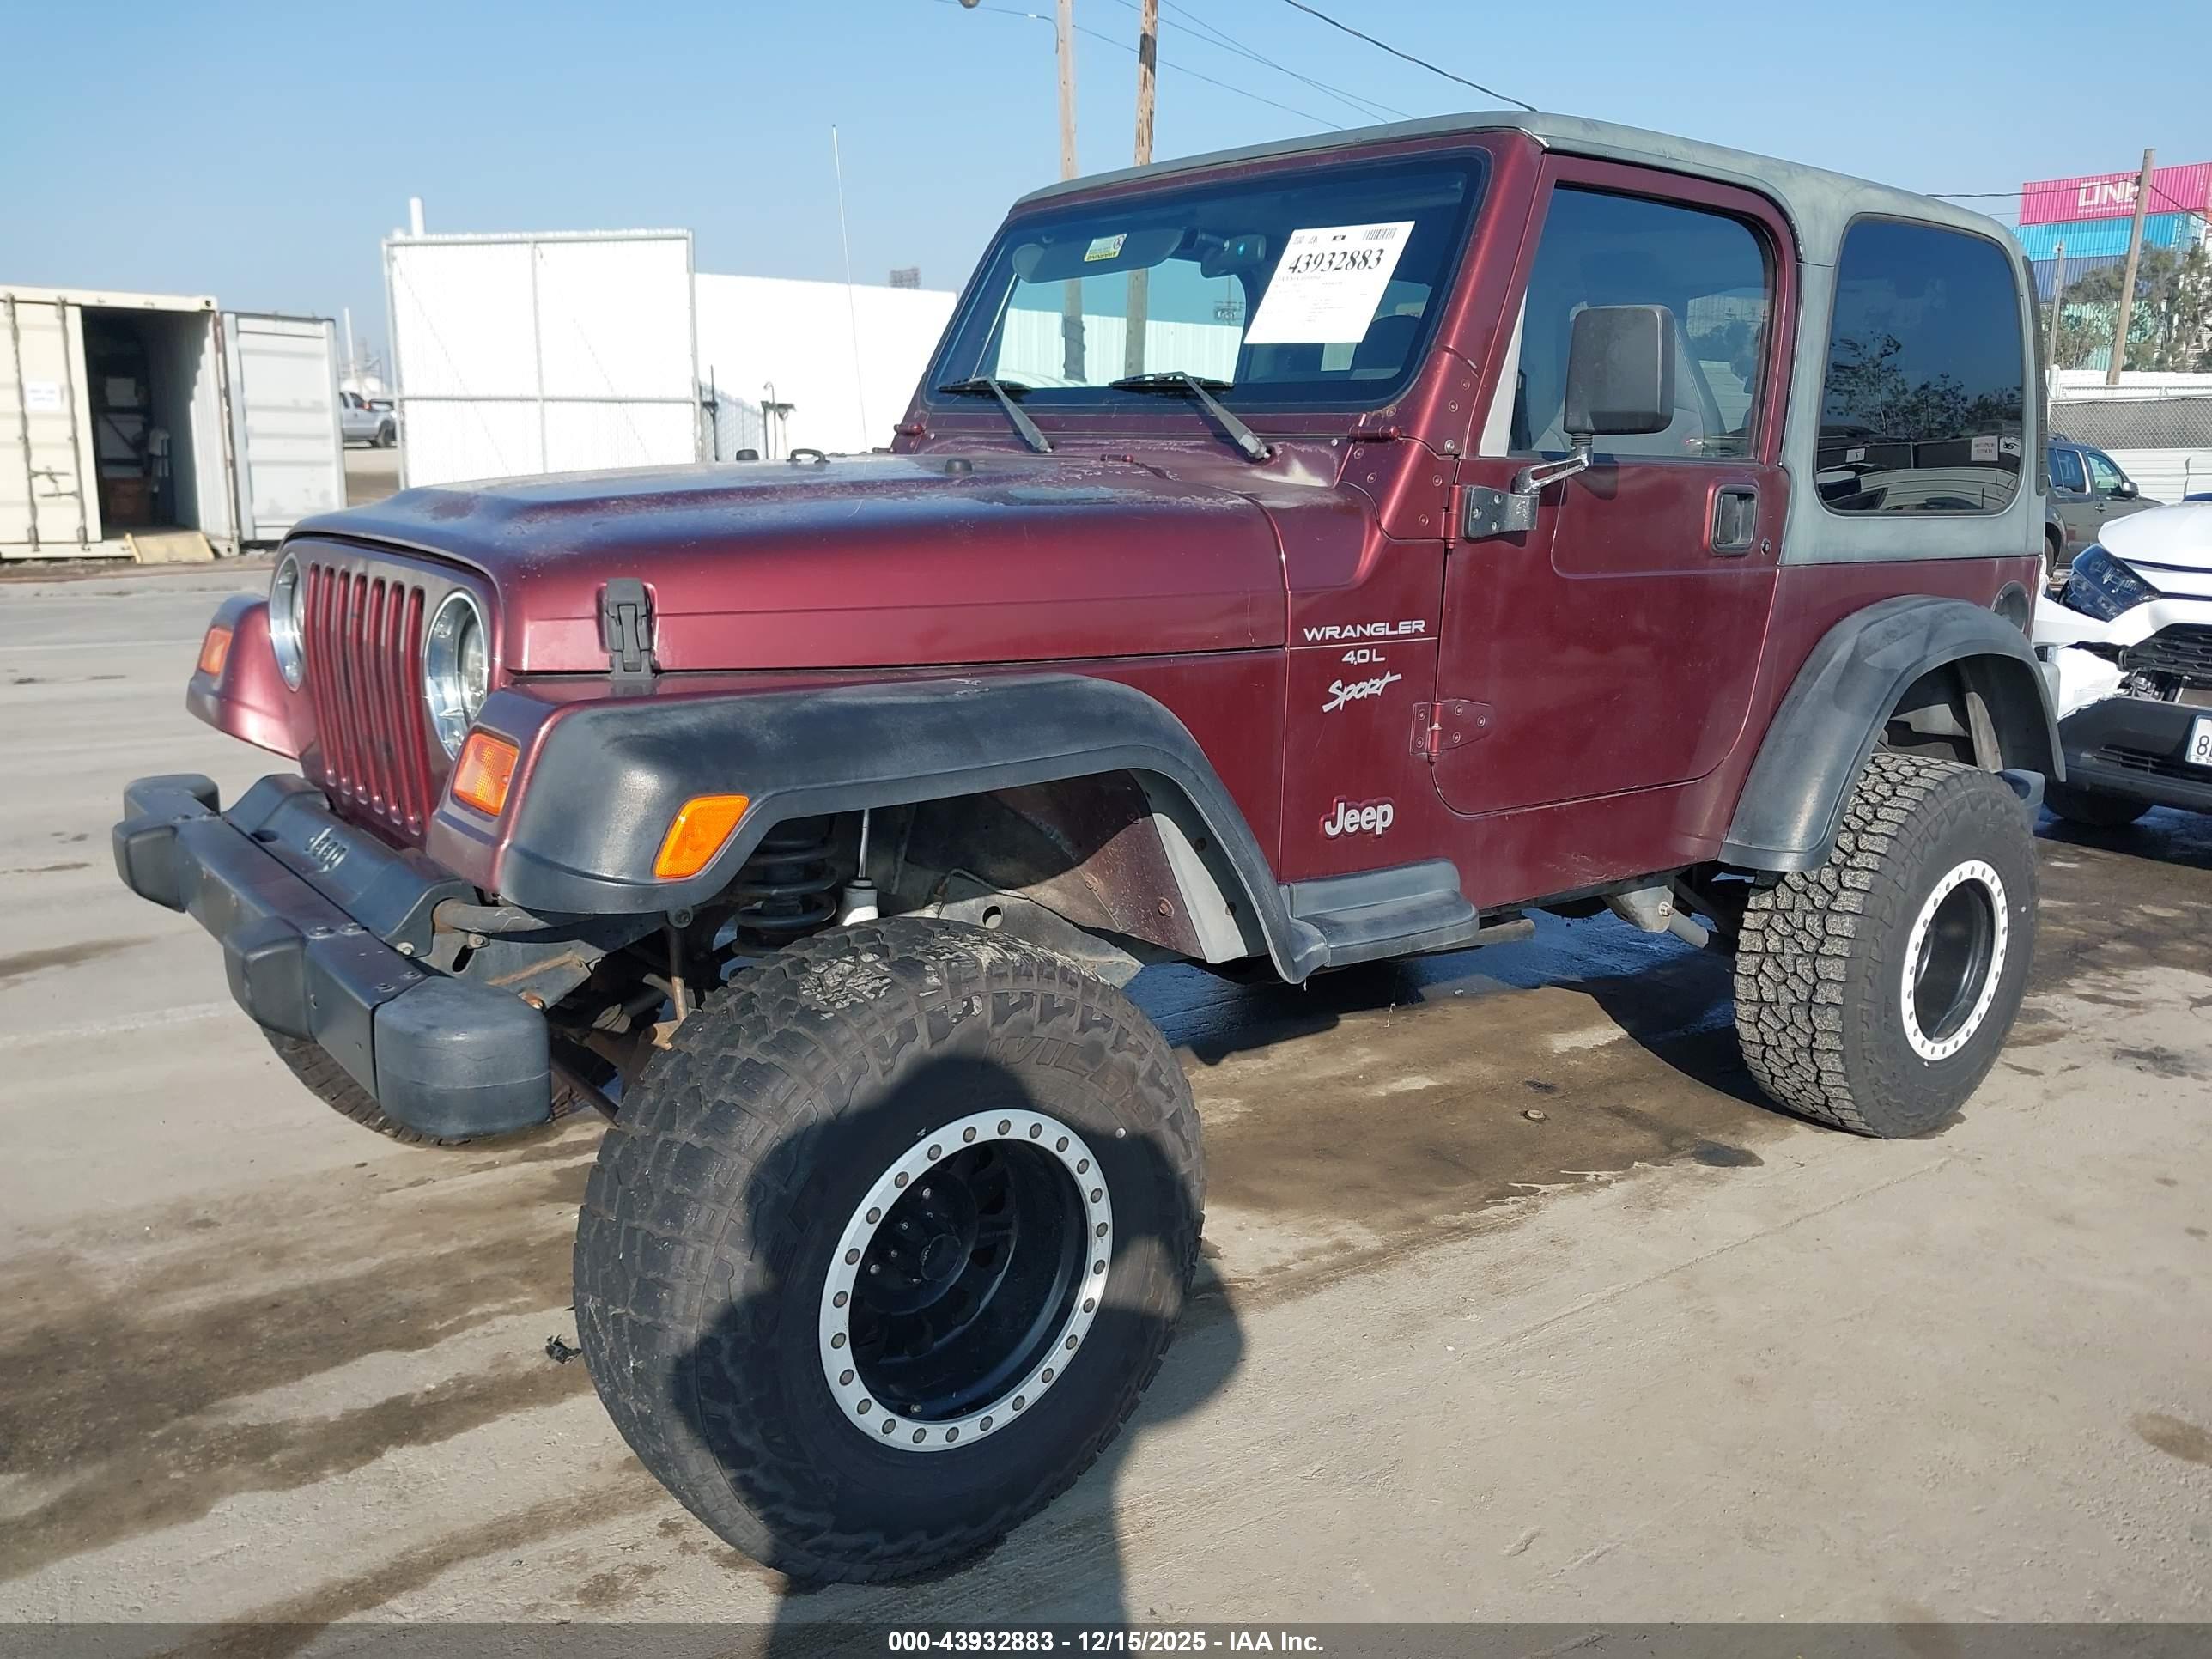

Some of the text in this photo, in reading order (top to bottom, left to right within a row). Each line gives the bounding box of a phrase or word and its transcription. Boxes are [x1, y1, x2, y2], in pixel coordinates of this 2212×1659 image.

[1288, 249, 1384, 274] 43932883
[1304, 620, 1425, 641] WRANGLER
[1325, 803, 1393, 836] Jeep
[309, 827, 346, 873] Jeep
